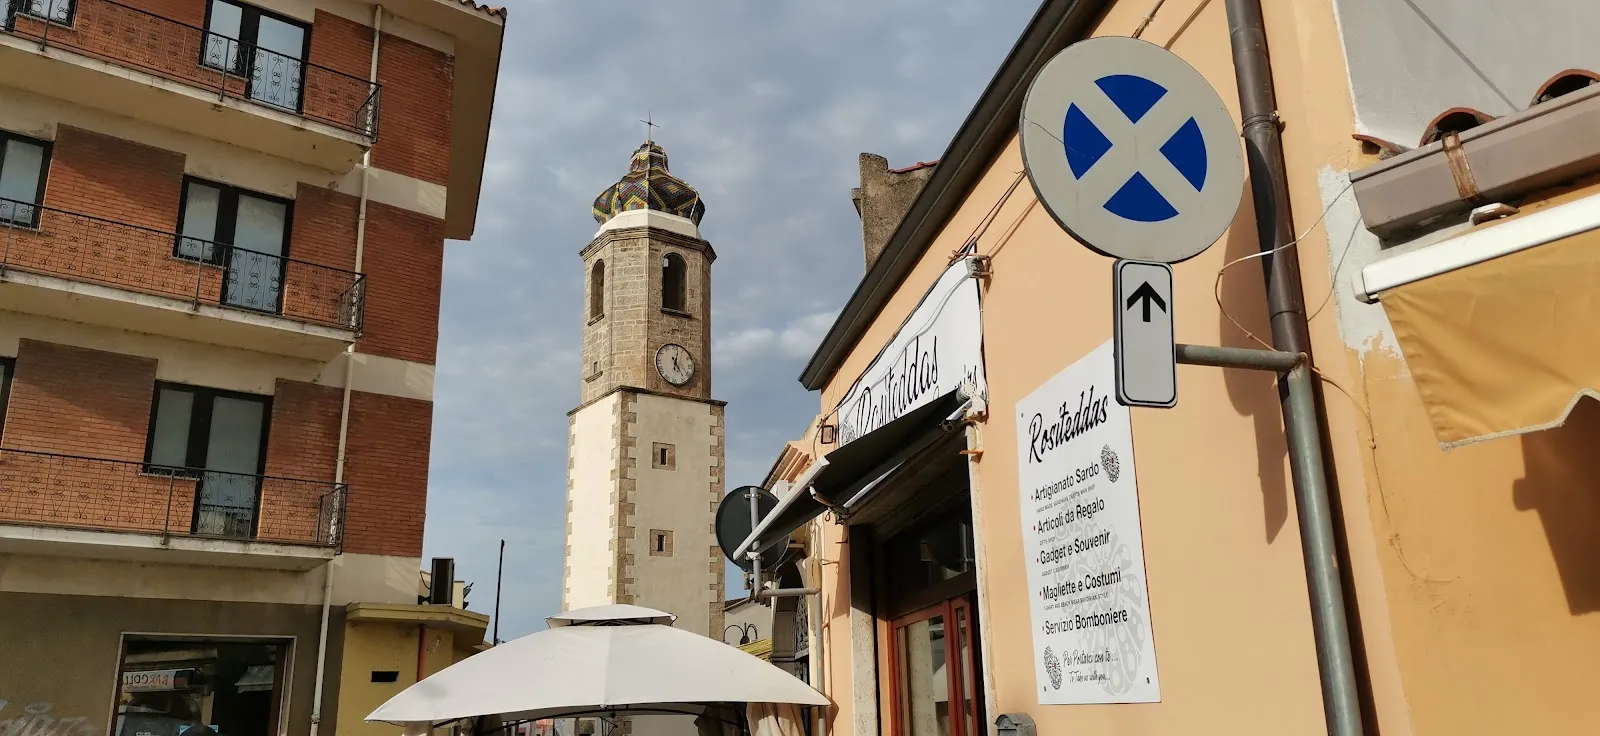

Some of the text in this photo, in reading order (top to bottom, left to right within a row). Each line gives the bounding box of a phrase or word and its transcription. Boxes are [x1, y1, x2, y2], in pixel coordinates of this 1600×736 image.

[1028, 384, 1109, 464] Rositeddas
[1034, 462, 1099, 502] Artigianato Sardo
[1037, 496, 1105, 534] Articoli da Regalo
[1040, 529, 1111, 564] Gadget e Souvenir
[1042, 566, 1122, 601] Magliette e Costumi
[1045, 607, 1128, 635] Servizio Bomboniere
